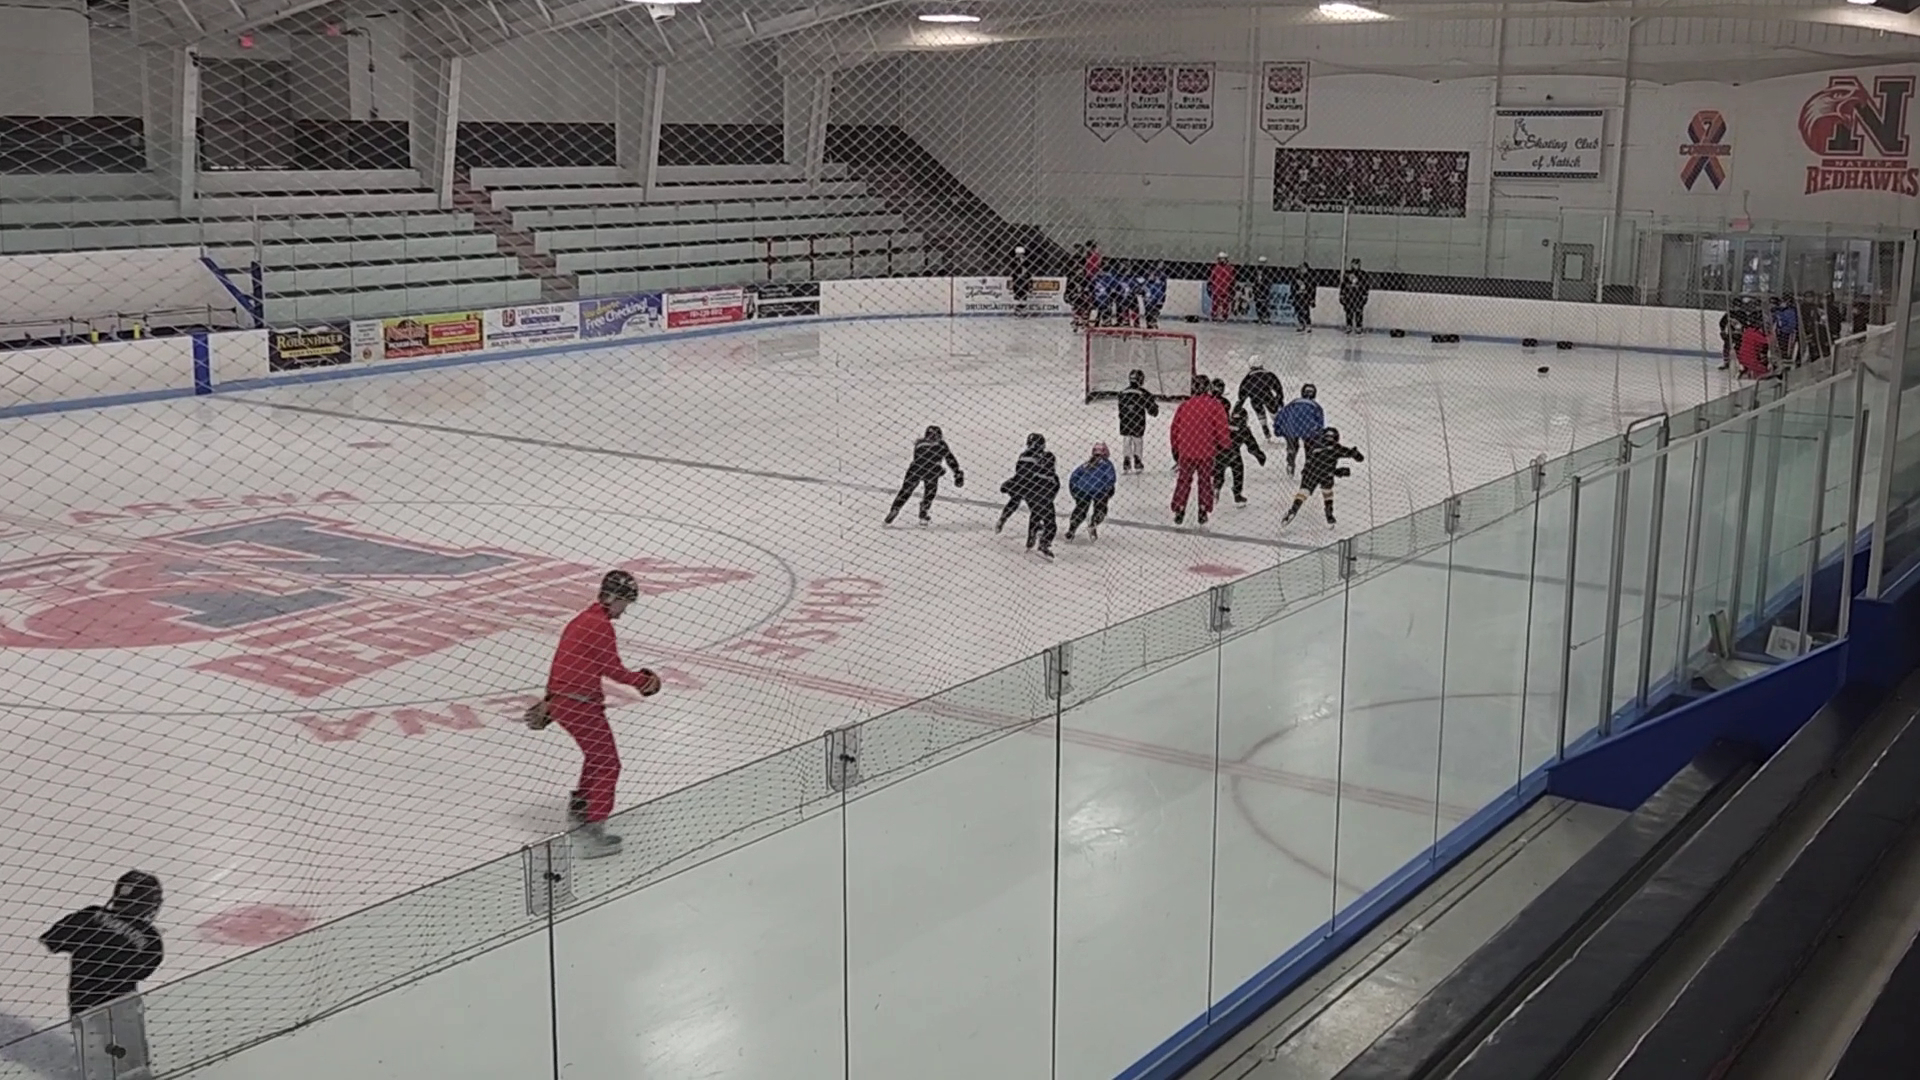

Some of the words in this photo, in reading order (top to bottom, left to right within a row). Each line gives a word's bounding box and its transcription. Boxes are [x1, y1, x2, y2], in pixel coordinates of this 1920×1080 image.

[1526, 134, 1568, 152] Skating
[1574, 137, 1599, 150] Club
[1532, 155, 1544, 170] of
[1546, 155, 1581, 168] Natick
[1834, 160, 1894, 168] NATICK
[1804, 165, 1919, 198] REDHAWKS
